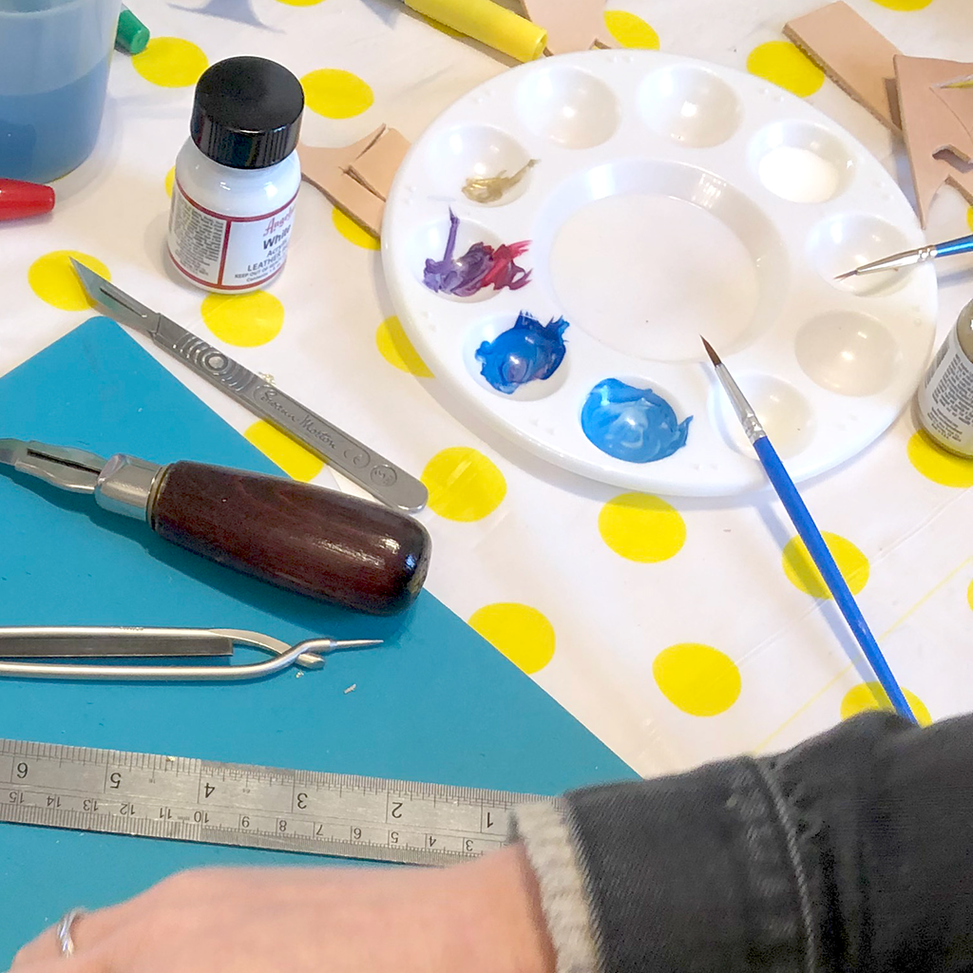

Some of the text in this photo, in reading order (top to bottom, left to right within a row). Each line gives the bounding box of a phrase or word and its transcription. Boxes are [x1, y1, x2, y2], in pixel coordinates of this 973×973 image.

[247, 250, 281, 272] LEATHER
[17, 762, 27, 778] 6
[110, 772, 121, 789] 5
[205, 782, 215, 798] 4
[9, 792, 25, 804] 15
[47, 796, 61, 808] 14
[297, 792, 308, 809] 3
[83, 800, 98, 812] 13
[119, 804, 135, 815] 12
[391, 802, 403, 818] 2
[159, 808, 172, 820] 11
[193, 810, 209, 824] 10
[487, 812, 493, 828] 1
[241, 816, 249, 828] 9
[279, 820, 287, 832] 8
[316, 824, 323, 836] 7
[353, 827, 361, 840] 6
[391, 832, 399, 844] 5
[429, 836, 437, 847] 4
[465, 840, 473, 852] 3
